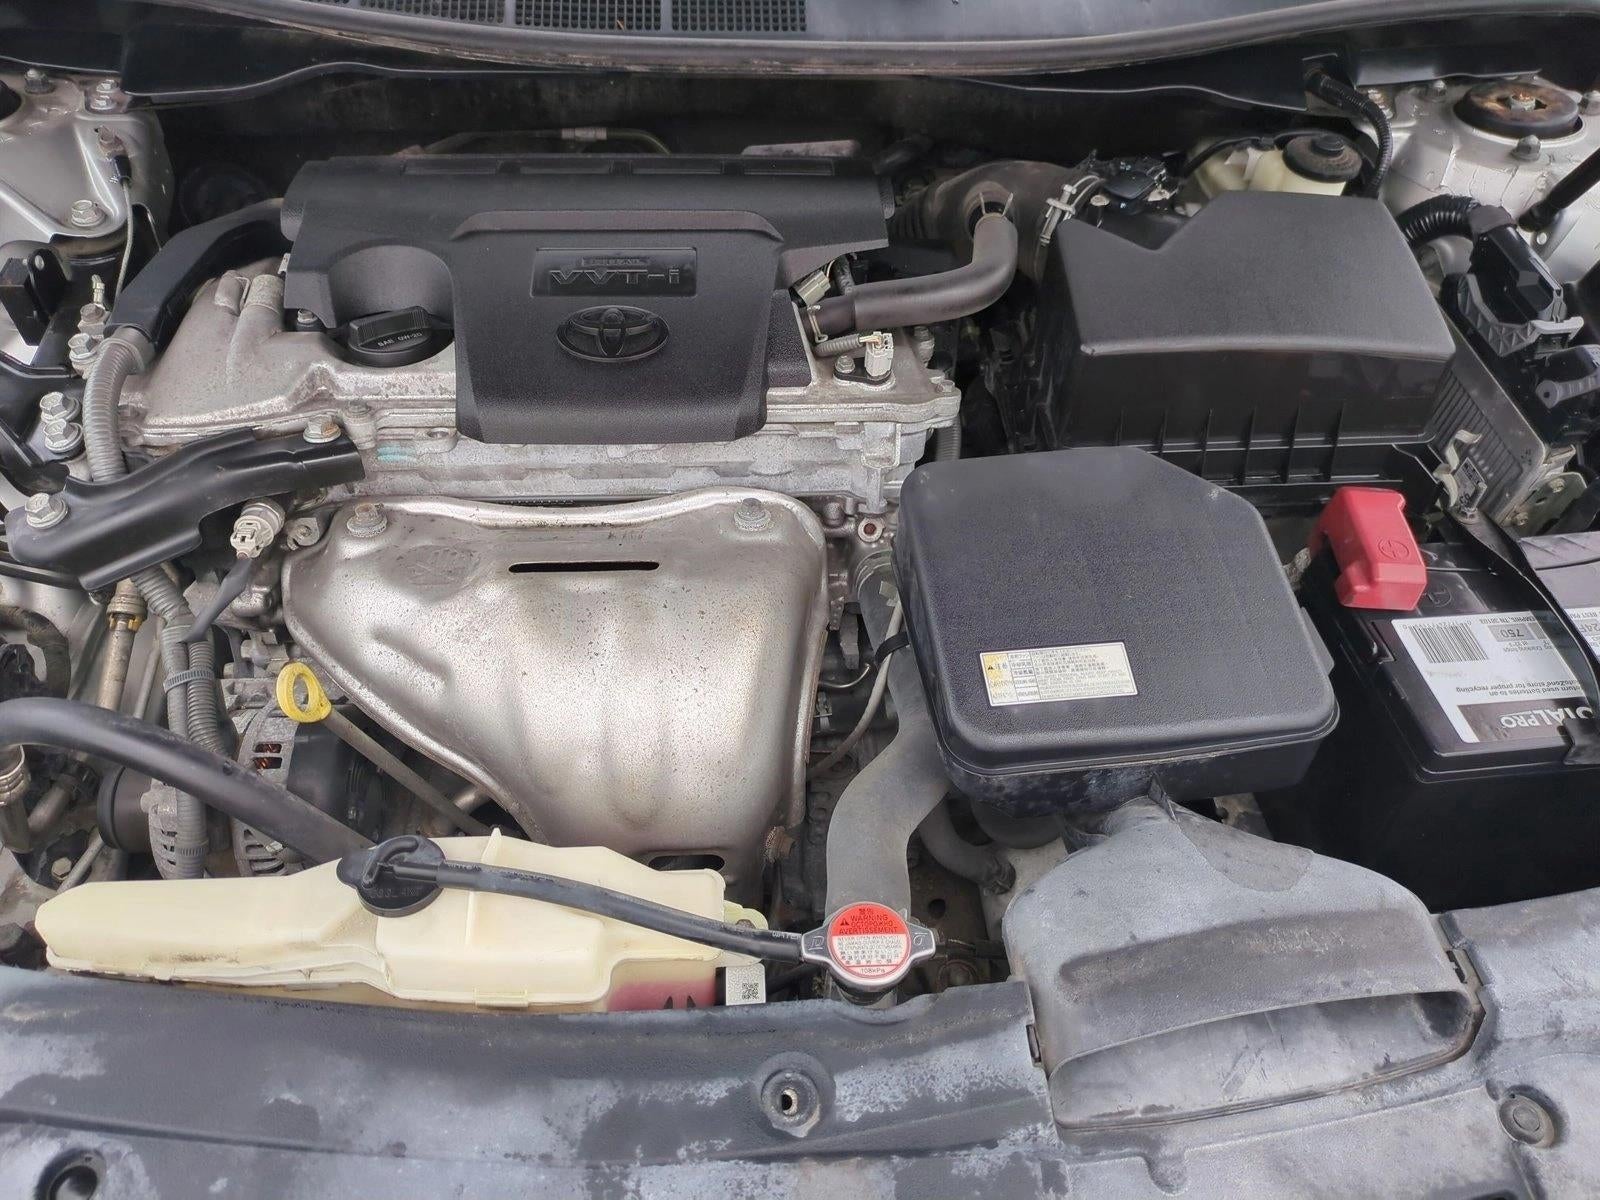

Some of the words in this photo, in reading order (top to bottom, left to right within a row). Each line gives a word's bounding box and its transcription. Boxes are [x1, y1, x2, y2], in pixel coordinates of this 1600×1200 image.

[549, 268, 680, 285] VVT-i
[377, 339, 395, 347] SAE
[1499, 628, 1525, 638] 750
[1456, 685, 1489, 693] recycling
[1490, 683, 1513, 691] proper
[1509, 687, 1542, 695] batteries
[850, 914, 888, 922] WARNING
[839, 926, 898, 935] AVERTISSEMENT
